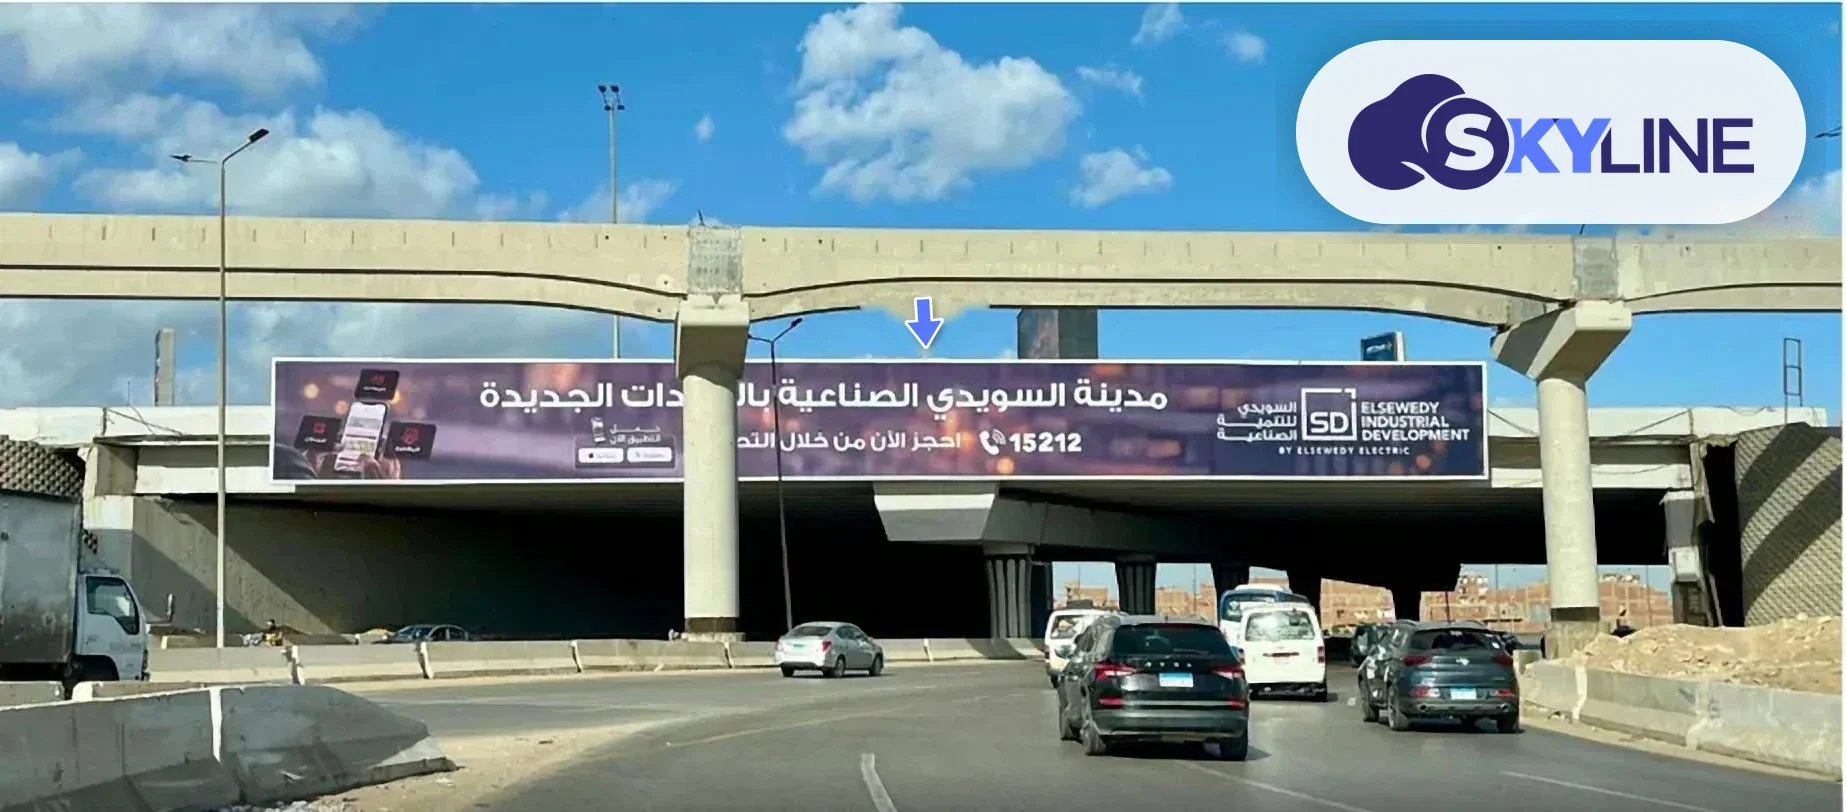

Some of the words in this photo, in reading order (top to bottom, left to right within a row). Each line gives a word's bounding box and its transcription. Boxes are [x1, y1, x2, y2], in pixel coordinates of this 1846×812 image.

[479, 378, 614, 413] الجديدة
[778, 377, 919, 413] الصناعية
[926, 381, 1067, 421] السويدي
[1073, 377, 1169, 413] مدينة
[1360, 401, 1440, 415] ELSEWEDY
[1309, 411, 1350, 435] SD
[1360, 415, 1450, 428] INDUSTRIAL
[780, 431, 829, 451] خلال
[833, 431, 866, 451] من
[911, 431, 961, 451] احجز
[1008, 431, 1082, 453] 15212
[1215, 427, 1298, 443] الصناعية
[1360, 428, 1471, 442] DEVELOPMENT
[1278, 446, 1292, 455] BY
[1297, 446, 1354, 455] ELSEWEDY
[1358, 446, 1410, 455] ELECTRIC
